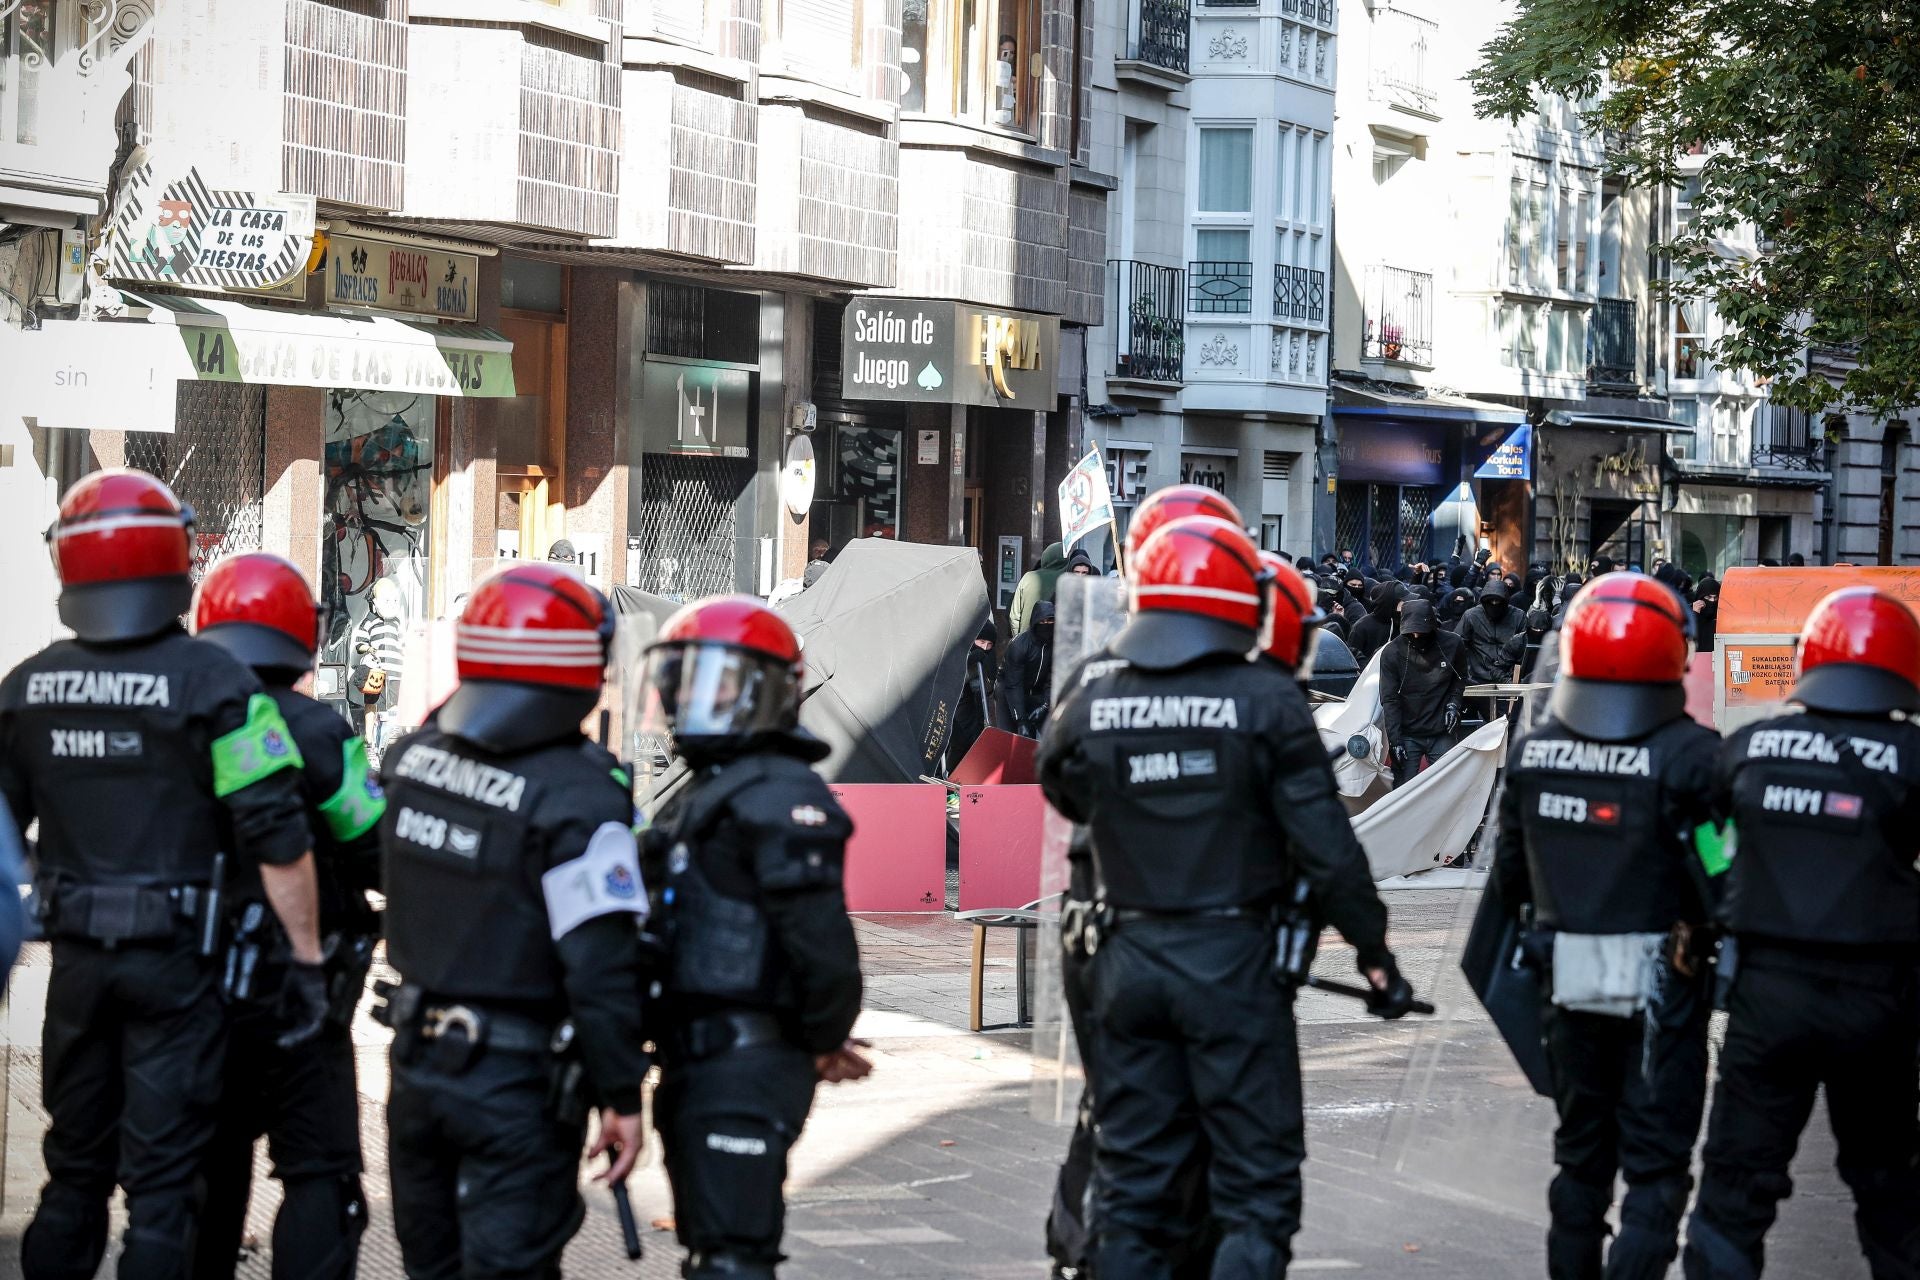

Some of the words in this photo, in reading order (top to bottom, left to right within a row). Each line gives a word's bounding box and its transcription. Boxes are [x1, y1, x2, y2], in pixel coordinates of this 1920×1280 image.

[212, 209, 232, 227] LA
[240, 211, 284, 232] CASA
[217, 231, 234, 246] DE
[241, 234, 264, 248] LAS
[200, 248, 267, 271] FIESTAS
[335, 256, 378, 303] DISFRACES
[388, 250, 428, 299] REGALOS
[437, 276, 467, 314] BROMAS
[855, 309, 906, 344] Salón
[911, 312, 934, 345] de
[197, 332, 225, 375] LA
[853, 351, 909, 389] Juego
[55, 364, 88, 387] sin
[1486, 455, 1522, 465] Korkula
[1496, 443, 1523, 456] Viajes
[1497, 465, 1522, 475] Tours
[26, 670, 170, 708] ERTZAINTZA
[924, 700, 946, 761] KELER
[1089, 695, 1239, 732] ERTZAINTZA
[50, 728, 106, 758] X1H1
[1520, 739, 1651, 777] ERTZAINTZA
[395, 743, 527, 812] ERTZAINTZA
[1762, 784, 1823, 816] H1V1
